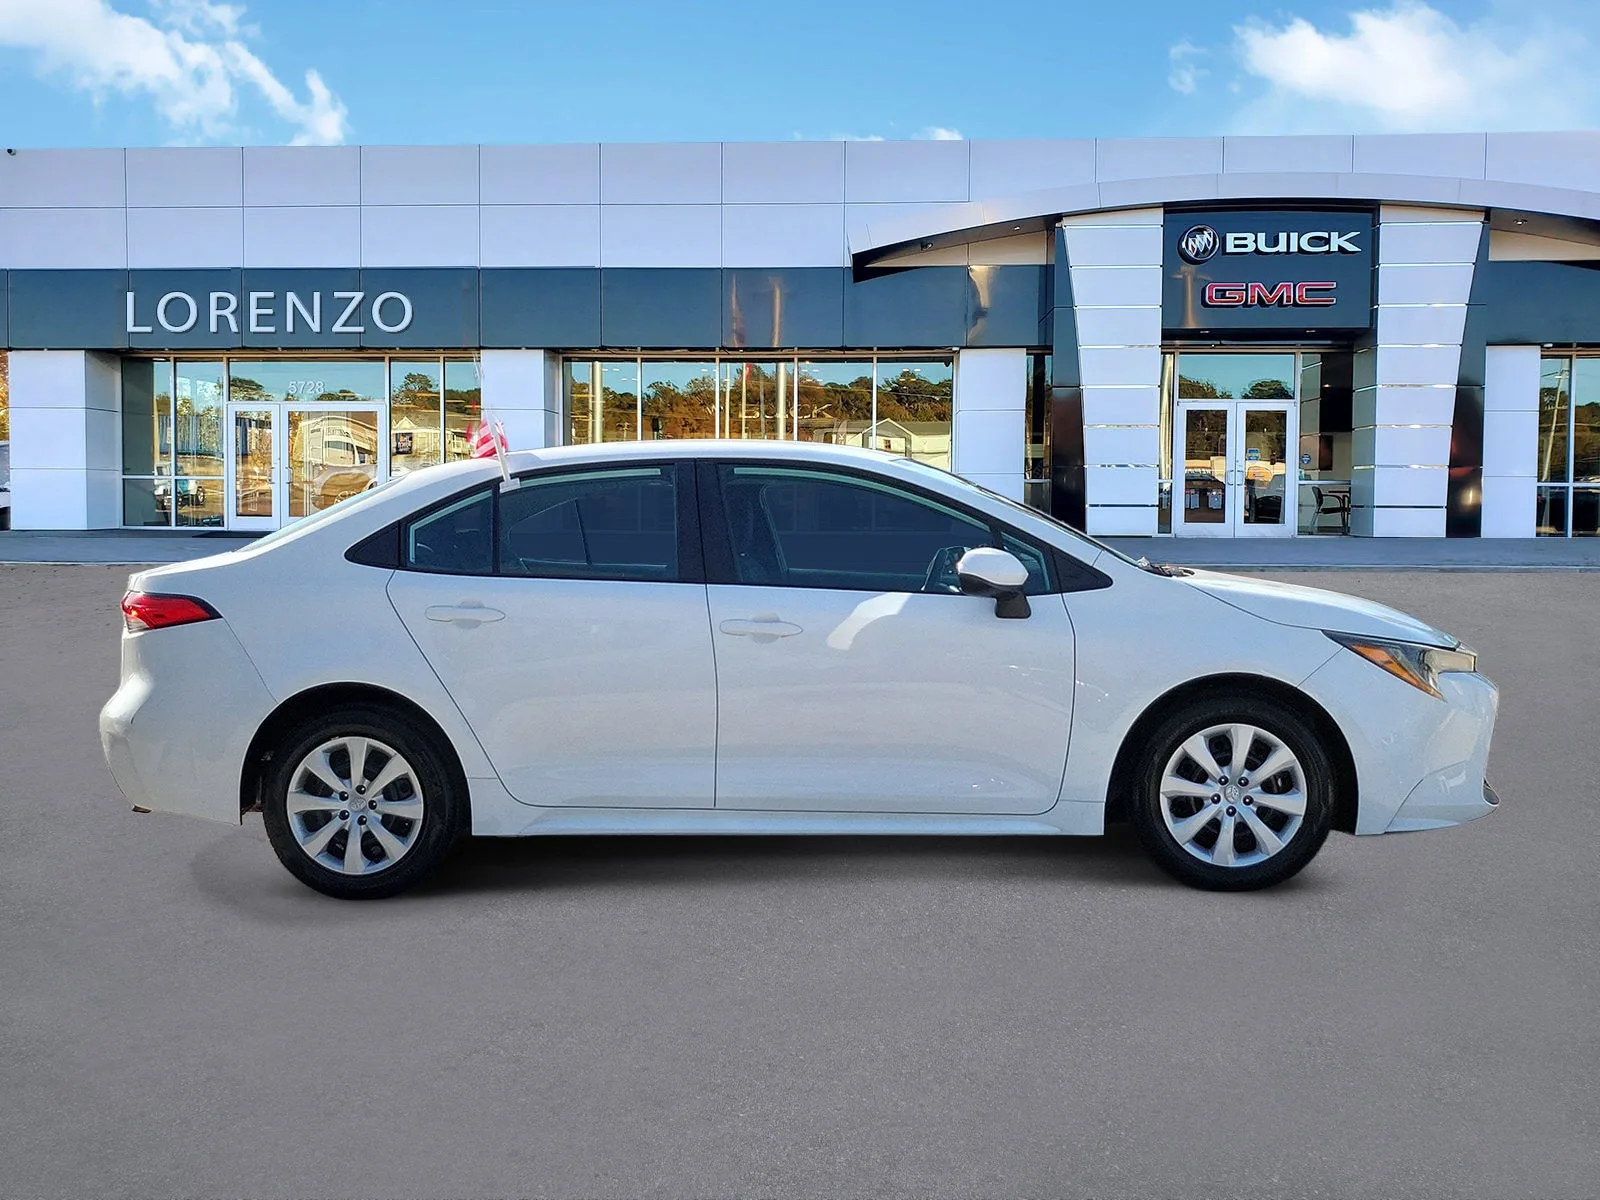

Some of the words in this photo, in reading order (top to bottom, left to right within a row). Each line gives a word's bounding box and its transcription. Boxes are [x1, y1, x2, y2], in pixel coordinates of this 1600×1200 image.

[1225, 231, 1362, 253] BUICK
[1204, 281, 1337, 305] GMC
[126, 291, 413, 333] LORENZO
[288, 380, 325, 394] 5728
